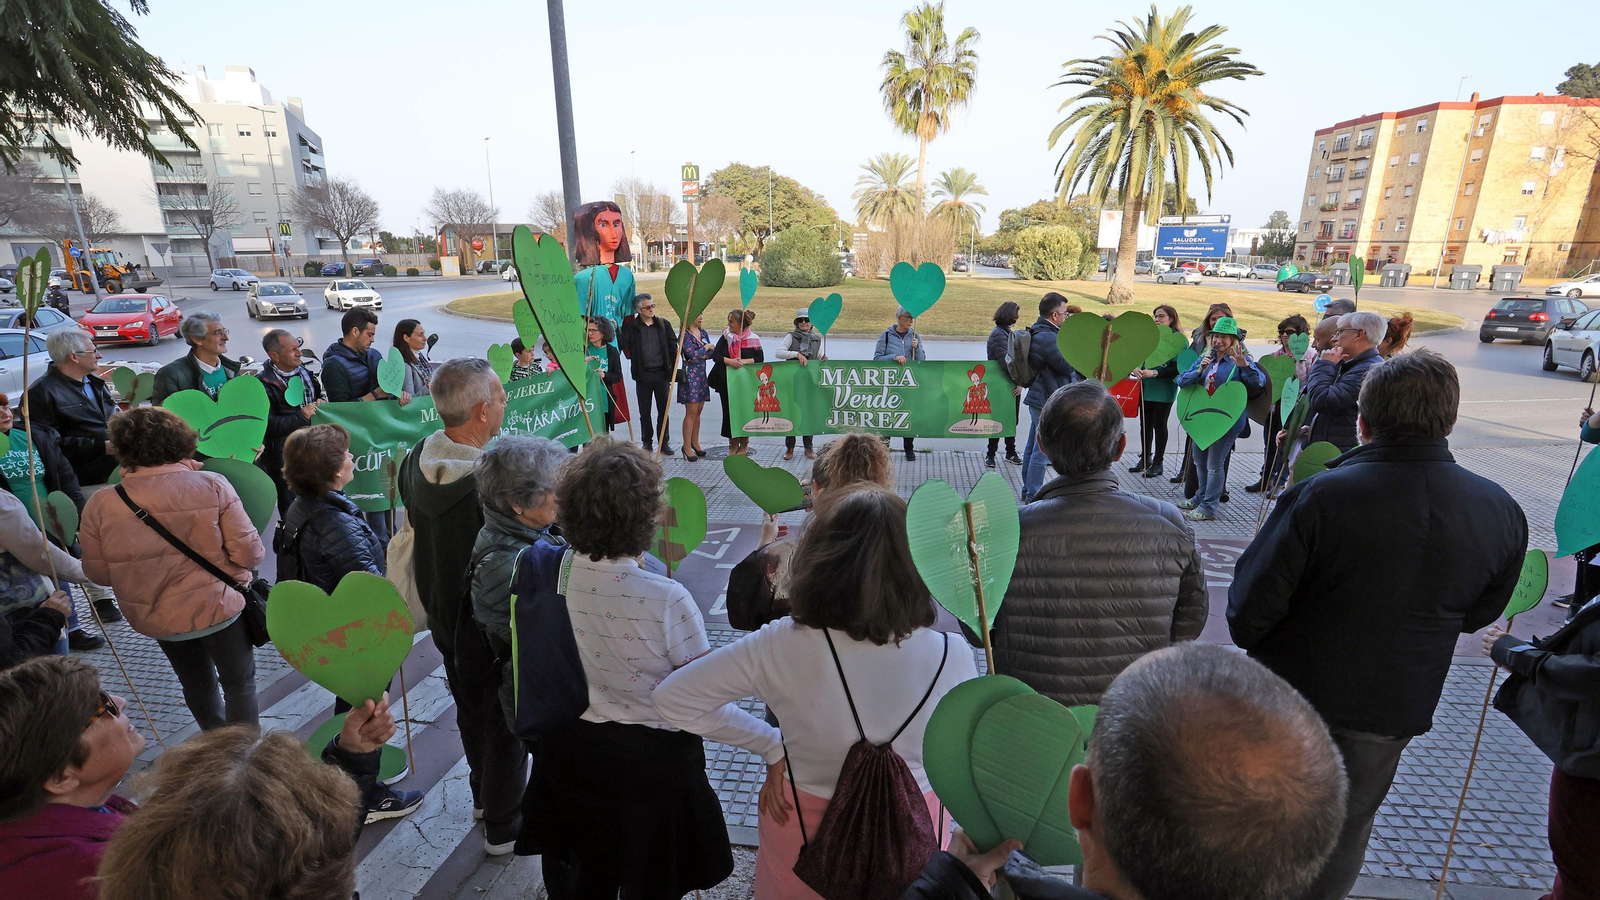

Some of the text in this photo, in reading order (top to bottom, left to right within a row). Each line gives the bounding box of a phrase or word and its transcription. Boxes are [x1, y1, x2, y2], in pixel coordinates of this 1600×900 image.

[820, 368, 918, 387] MAREA
[514, 381, 555, 400] JEREZ
[834, 385, 902, 409] Verde
[526, 410, 561, 433] PARA
[827, 410, 910, 429] JEREZ
